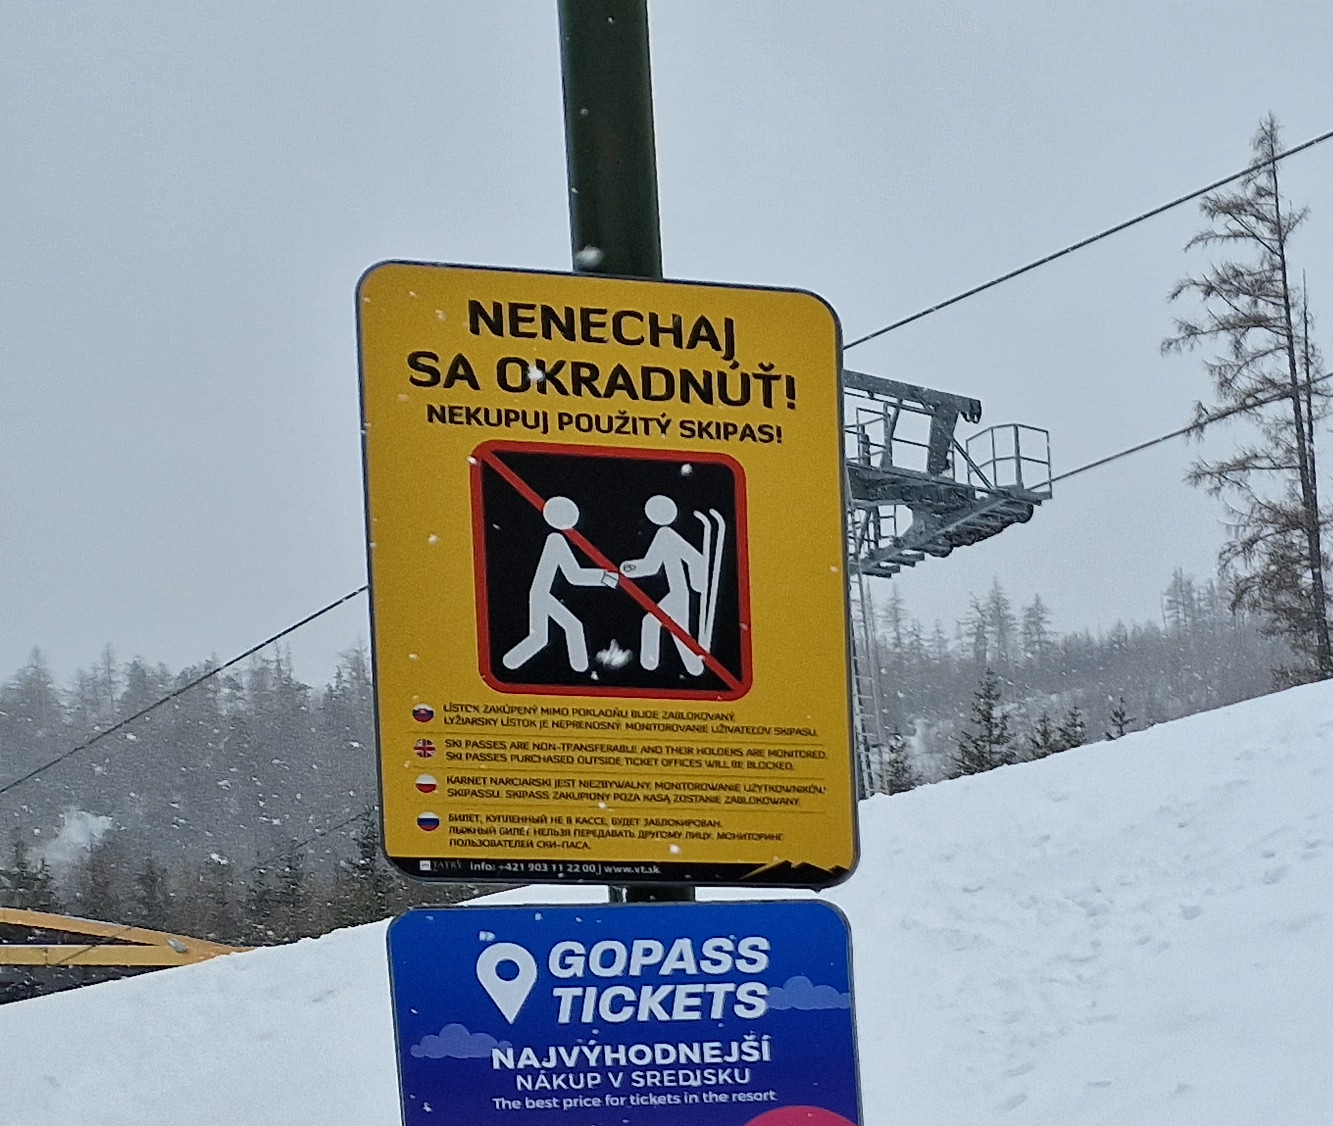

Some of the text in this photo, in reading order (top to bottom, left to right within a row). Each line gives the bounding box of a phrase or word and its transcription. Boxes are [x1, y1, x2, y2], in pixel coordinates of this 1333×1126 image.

[468, 300, 735, 361] NENECHAJ
[407, 351, 796, 410] SA OKRADNÚŤ!
[427, 404, 783, 444] NEKUPUJ POUŽITÝ SKIPAS!
[541, 706, 569, 716] MIMO
[631, 710, 658, 719] BUDE
[501, 717, 536, 728] LÍSTOK
[540, 720, 549, 729] JE
[625, 723, 708, 733] MONITOROVANIE
[445, 739, 462, 748] SKI
[465, 740, 507, 750] PASSES
[510, 742, 530, 751] ARE
[532, 742, 637, 753] NON-TRANSFERABLE
[640, 746, 662, 755] AND
[666, 746, 694, 756] THEIR
[697, 748, 743, 757] HOLDERS
[746, 749, 764, 758] ARE
[446, 752, 462, 761] SKI
[466, 753, 507, 763] PASSES
[510, 754, 574, 764] PURCHASED
[577, 756, 621, 766] OUTSIDE
[624, 757, 659, 767] TICKET
[661, 758, 702, 768] OFFICES
[705, 760, 730, 769] WILL
[731, 760, 744, 769] BE
[446, 776, 487, 786] KARNET
[490, 777, 550, 787] NARCIARSKI
[554, 779, 575, 789] JEST
[655, 782, 740, 792] MONITOROWANIE
[505, 790, 549, 800] SKIPASS
[552, 791, 611, 801] ZAKUPIONY
[613, 793, 640, 802] POZA
[643, 794, 670, 804] KASĄ
[673, 794, 721, 804] ZOSTANIE
[550, 816, 562, 825] НЕ
[566, 816, 572, 825] В
[611, 818, 640, 827] БУДЕТ
[449, 838, 533, 848] ПОЛЬЗОВАТЕЛЕЙ
[533, 828, 571, 837] НЕЛЬЗЯ
[638, 830, 683, 840] ДРУГОМУ
[498, 863, 524, 872] +421
[528, 864, 548, 872] 903
[552, 864, 563, 873] 11
[566, 864, 580, 873] 22
[582, 864, 596, 874] 00
[549, 936, 771, 978] GOPASS
[552, 982, 770, 1024] TICKETS
[492, 1034, 772, 1070] NAJVÝHODNEJŠÍ
[517, 1068, 751, 1091] NÁKUP V SREDISKU
[492, 1090, 777, 1111] The best price for tickets in the resort
